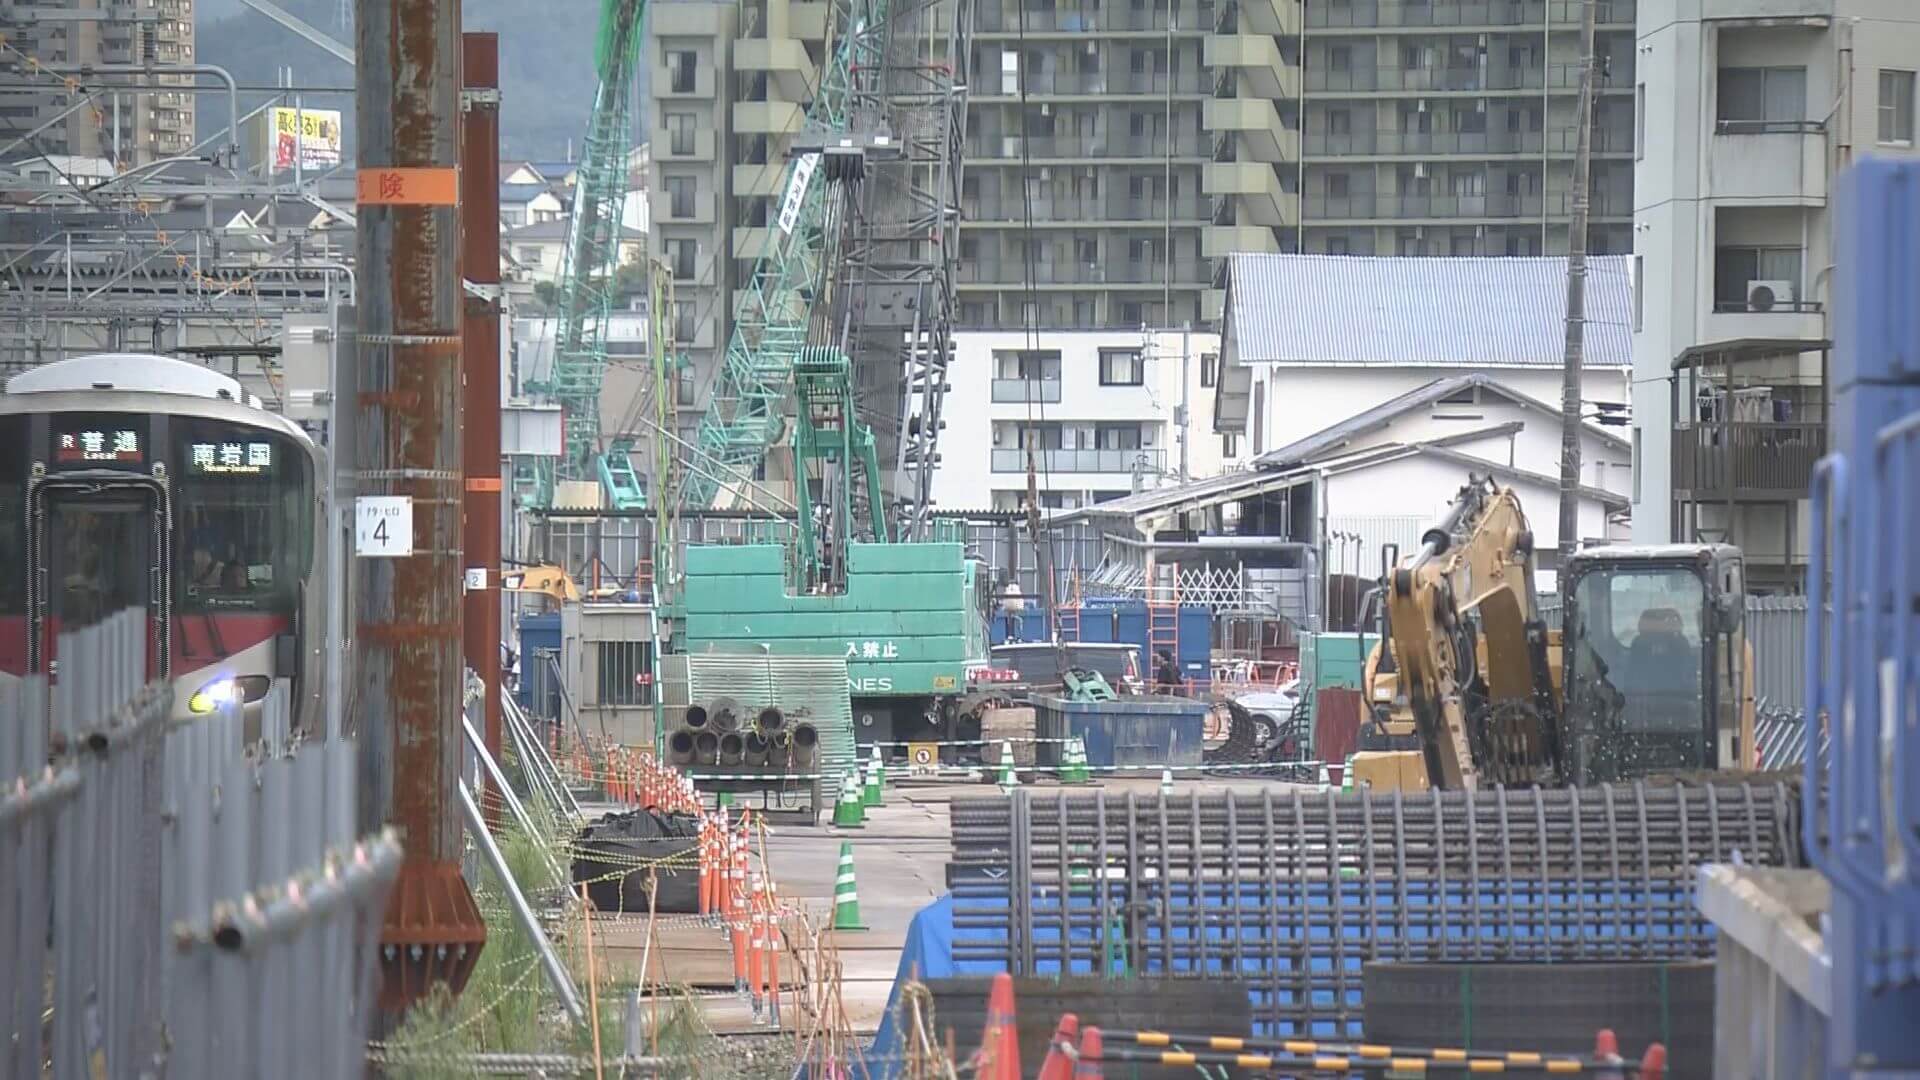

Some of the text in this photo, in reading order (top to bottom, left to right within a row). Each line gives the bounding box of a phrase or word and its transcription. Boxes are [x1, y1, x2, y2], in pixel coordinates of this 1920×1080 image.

[62, 430, 138, 452] R 普通
[83, 451, 117, 460] Local
[192, 443, 271, 466] 南岩国
[373, 517, 390, 547] 4
